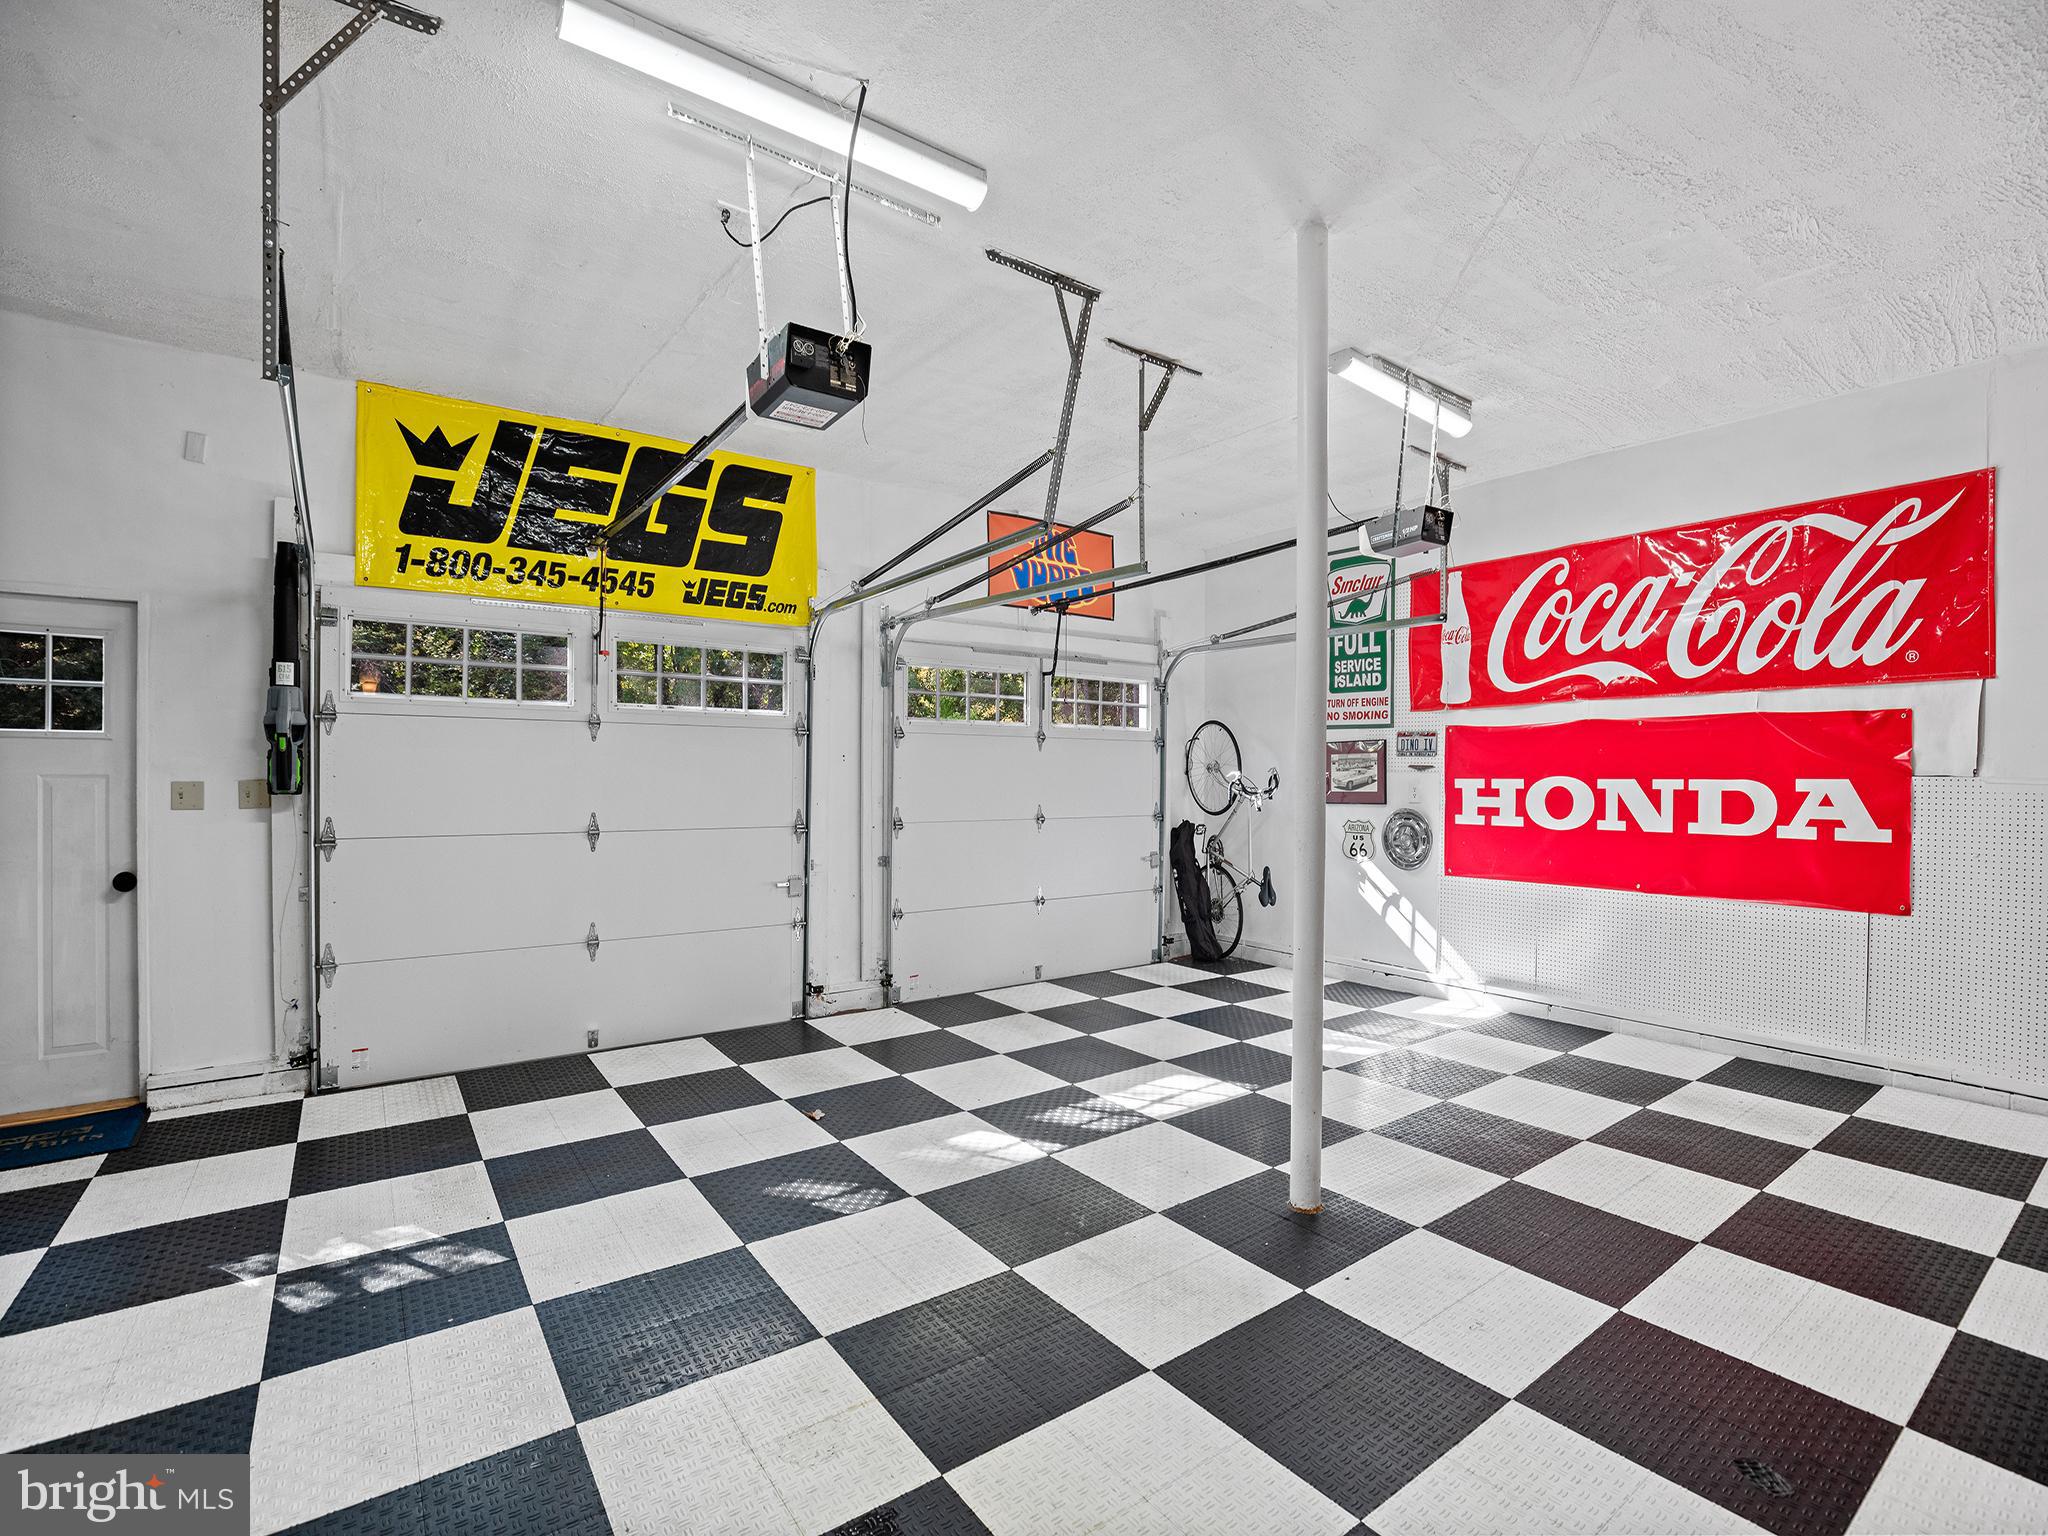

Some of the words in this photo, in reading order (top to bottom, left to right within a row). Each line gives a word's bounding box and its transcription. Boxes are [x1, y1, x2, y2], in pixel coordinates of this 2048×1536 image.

[397, 419, 794, 577] JEGS
[395, 543, 656, 598] 1-800-345-4545
[1331, 574, 1385, 596] Sinclair
[1486, 486, 1967, 693] Coca-Cola
[682, 577, 797, 614] JEGS.com
[1334, 632, 1381, 656] FULL
[1334, 657, 1382, 673] SERVICE
[1334, 672, 1382, 688] ISLAND
[1327, 699, 1345, 708] TURN
[1346, 698, 1360, 707] OFF
[1361, 697, 1389, 707] ENGINE
[1327, 711, 1340, 721] NO
[1342, 710, 1389, 720] SMOKING
[1401, 738, 1419, 751] DINO
[1424, 738, 1433, 751] IV
[1454, 775, 1893, 843] HONDA
[1347, 824, 1370, 832] ARIZONA
[1349, 842, 1368, 857] 66
